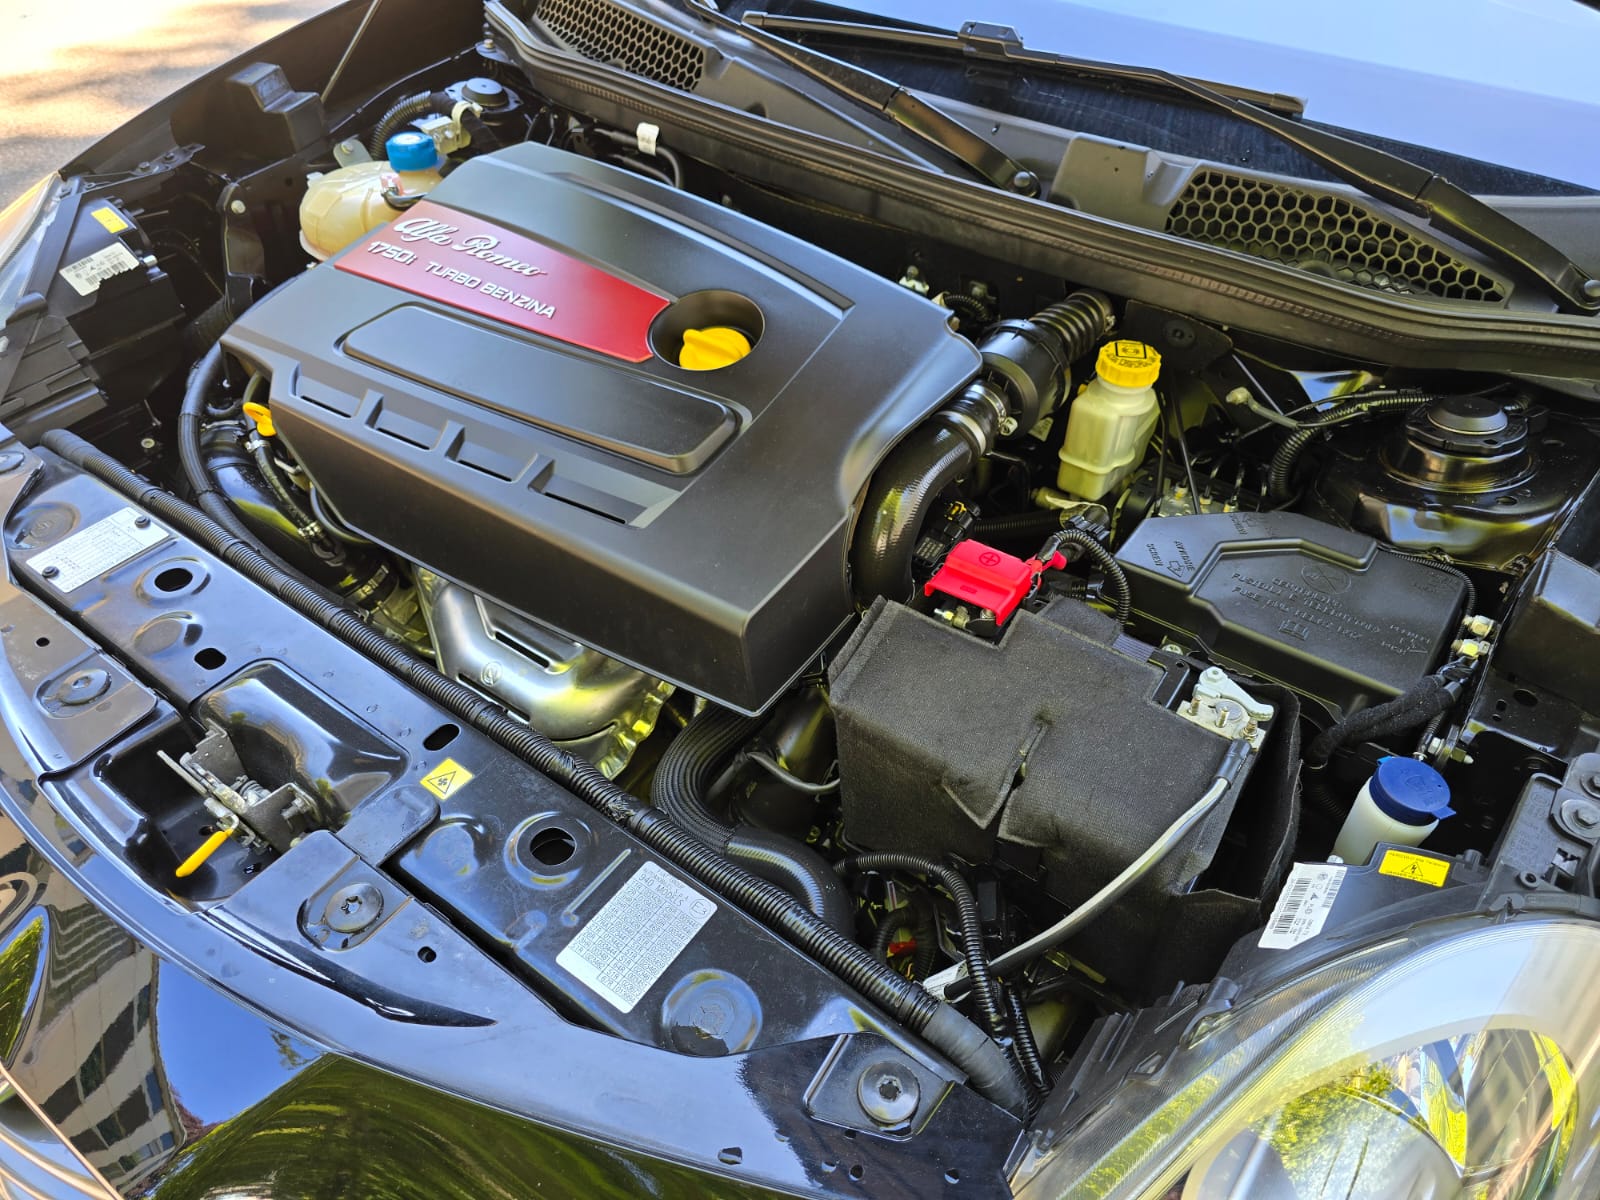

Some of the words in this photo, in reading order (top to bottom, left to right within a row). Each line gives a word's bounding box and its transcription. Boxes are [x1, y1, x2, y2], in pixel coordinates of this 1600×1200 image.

[393, 218, 460, 246] Alfa
[452, 233, 547, 277] Romeo
[425, 260, 481, 289] TURBO
[479, 281, 556, 319] BENZINA
[637, 873, 655, 887] 940
[654, 884, 685, 907] MODELS
[691, 900, 709, 917] E3
